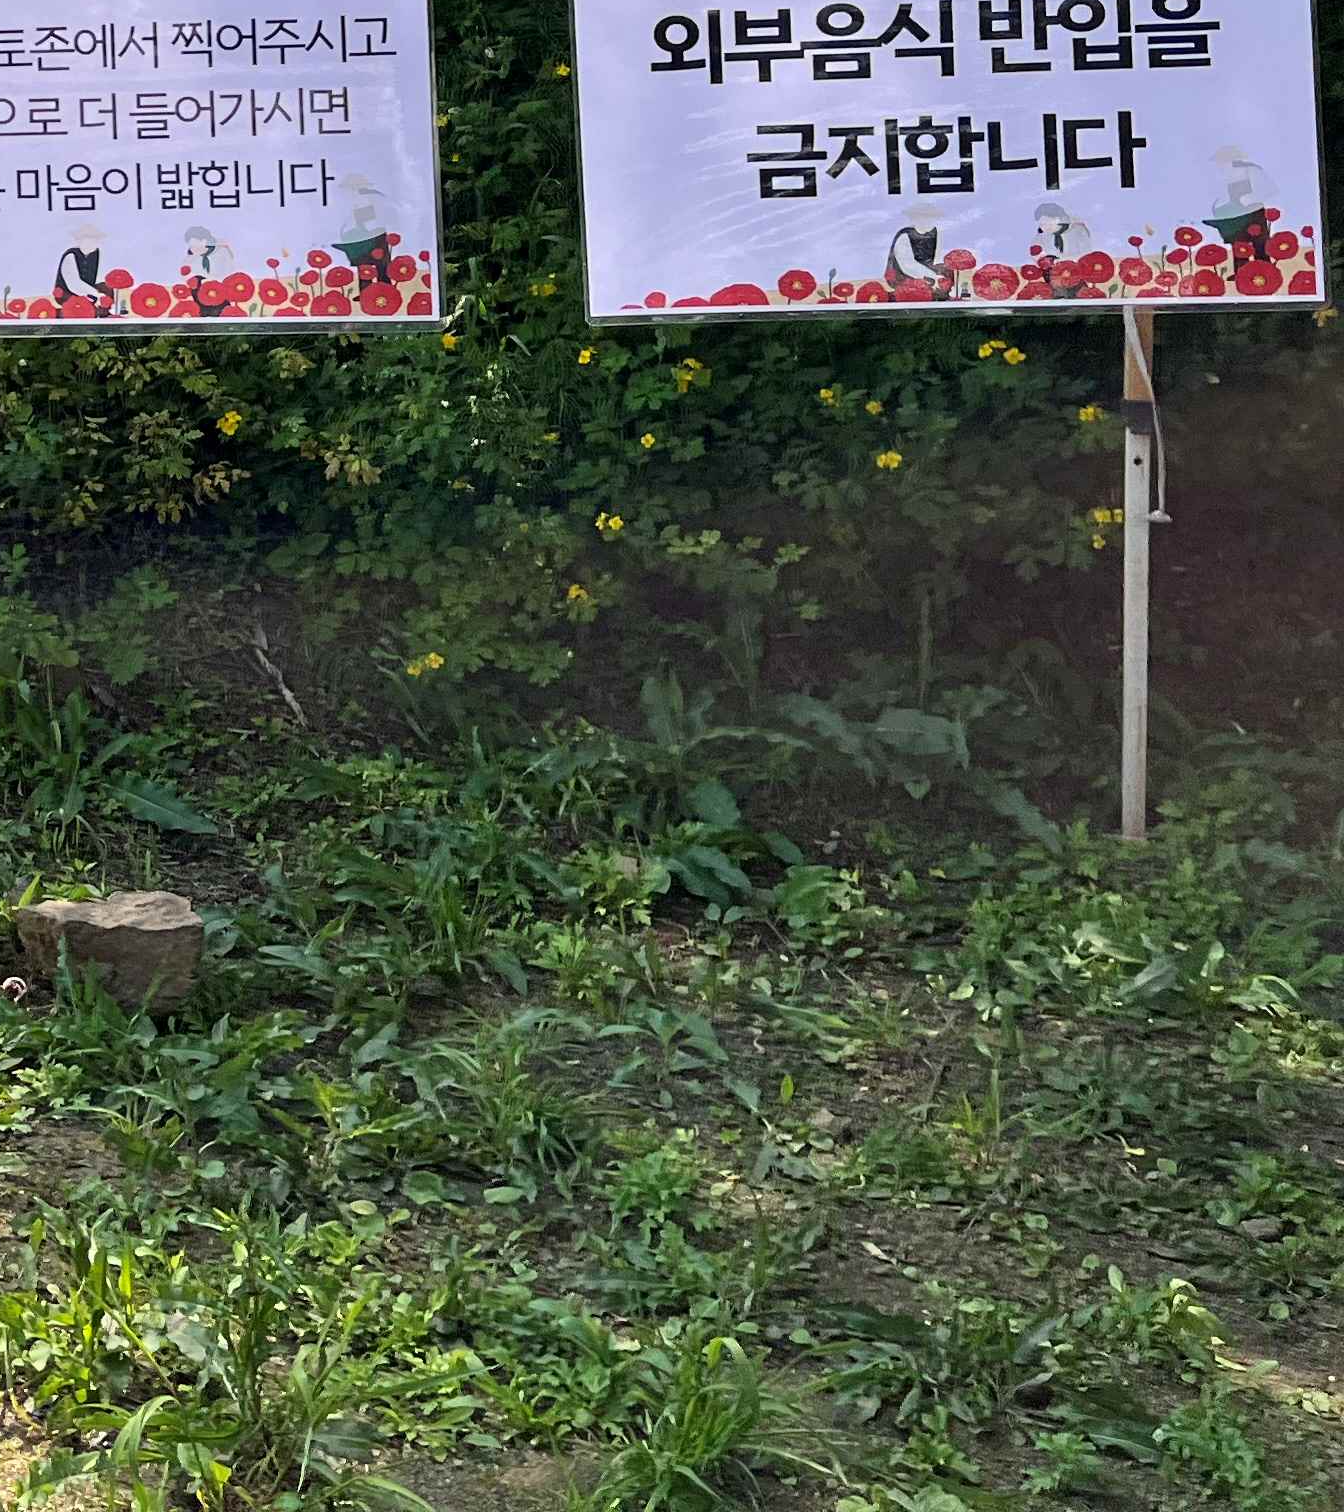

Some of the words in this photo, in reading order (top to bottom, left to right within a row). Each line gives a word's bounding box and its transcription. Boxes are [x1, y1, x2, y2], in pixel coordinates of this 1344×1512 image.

[170, 14, 398, 70] 찍어주시고
[78, 92, 119, 140] 더
[129, 86, 352, 140] 들어가시면
[746, 110, 1147, 200] 금지합니다
[15, 162, 144, 212] 마음이
[157, 158, 336, 211] 밟힙니다
